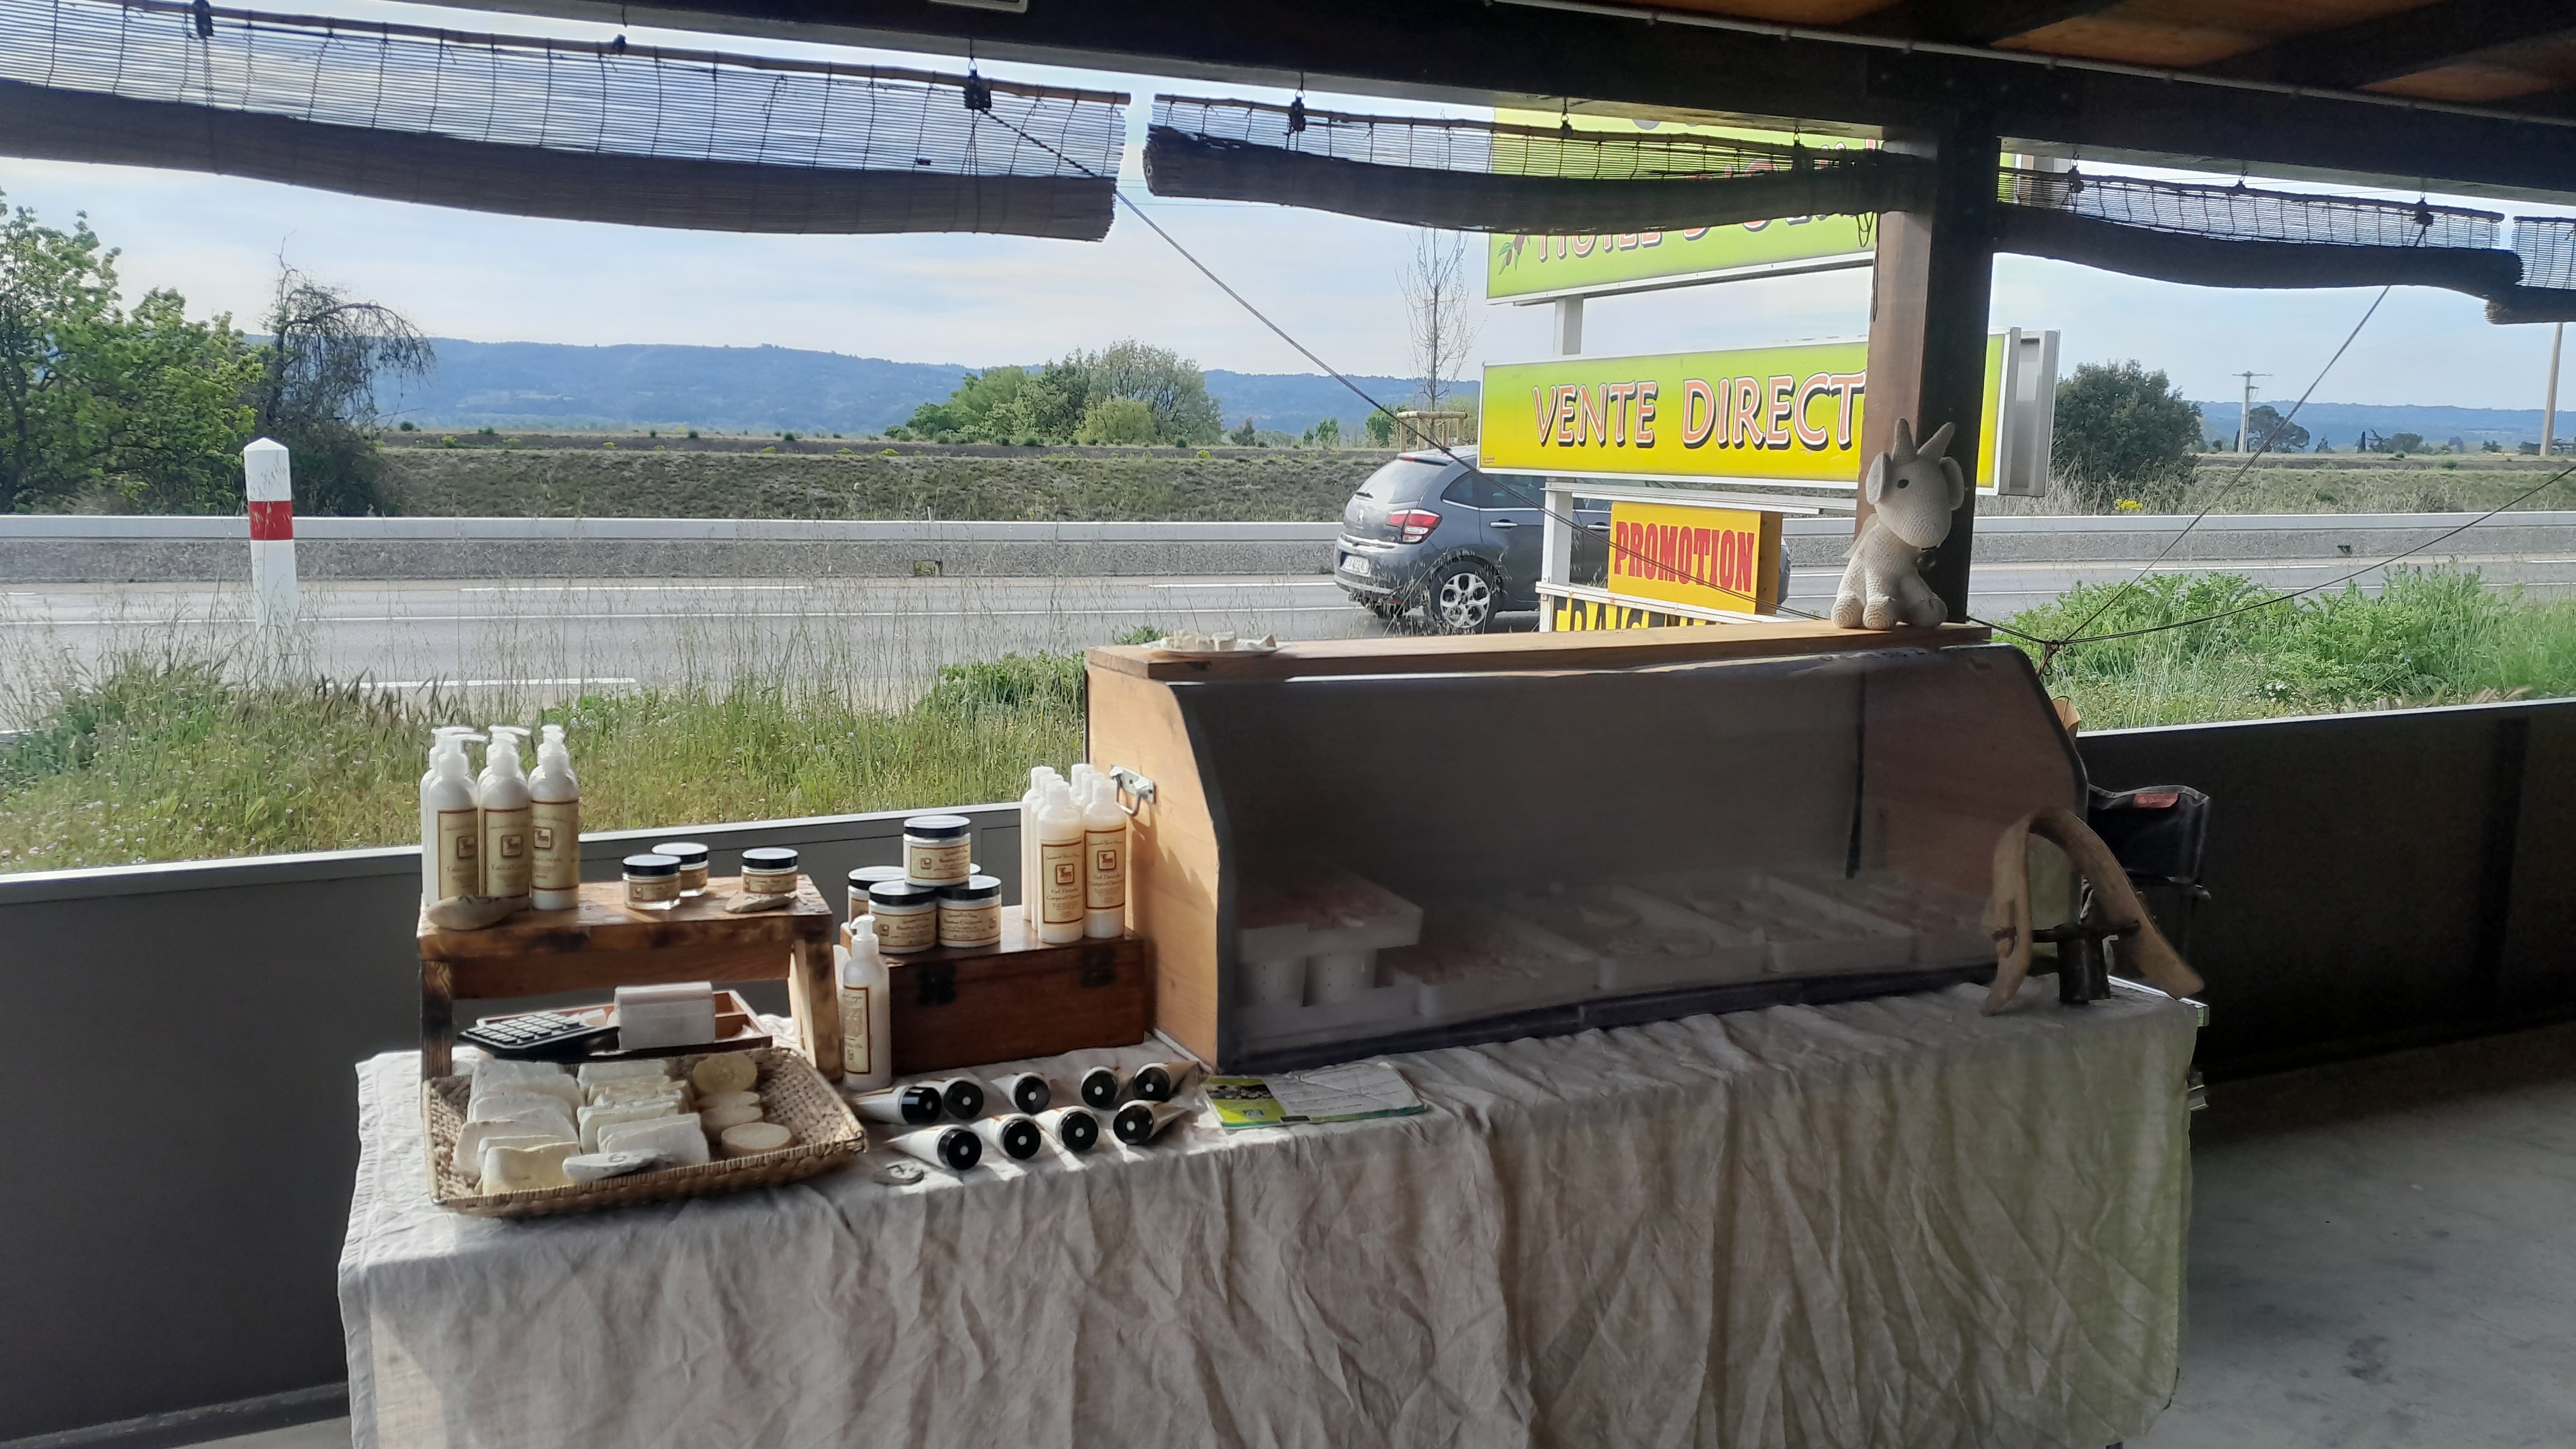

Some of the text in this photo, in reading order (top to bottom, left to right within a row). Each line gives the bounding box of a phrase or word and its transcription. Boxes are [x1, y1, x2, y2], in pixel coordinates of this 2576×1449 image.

[1532, 371, 1866, 451] VENTE DIRECT
[1614, 521, 1755, 593] PROMOTION
